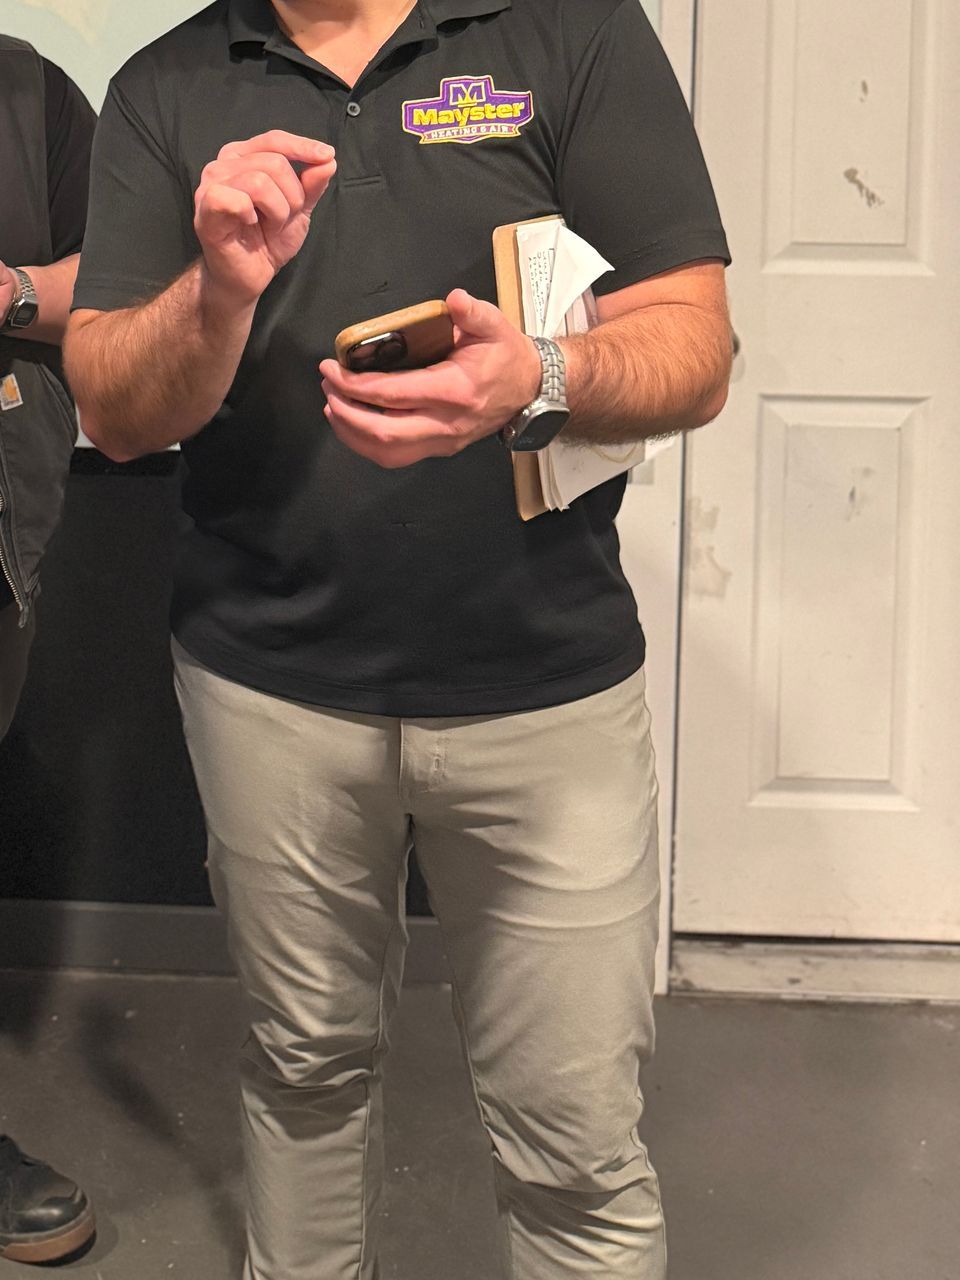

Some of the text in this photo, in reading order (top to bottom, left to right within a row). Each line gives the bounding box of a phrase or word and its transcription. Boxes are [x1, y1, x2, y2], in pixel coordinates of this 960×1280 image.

[412, 101, 525, 127] Mayster
[431, 125, 478, 139] HEATING
[489, 124, 509, 134] AIR
